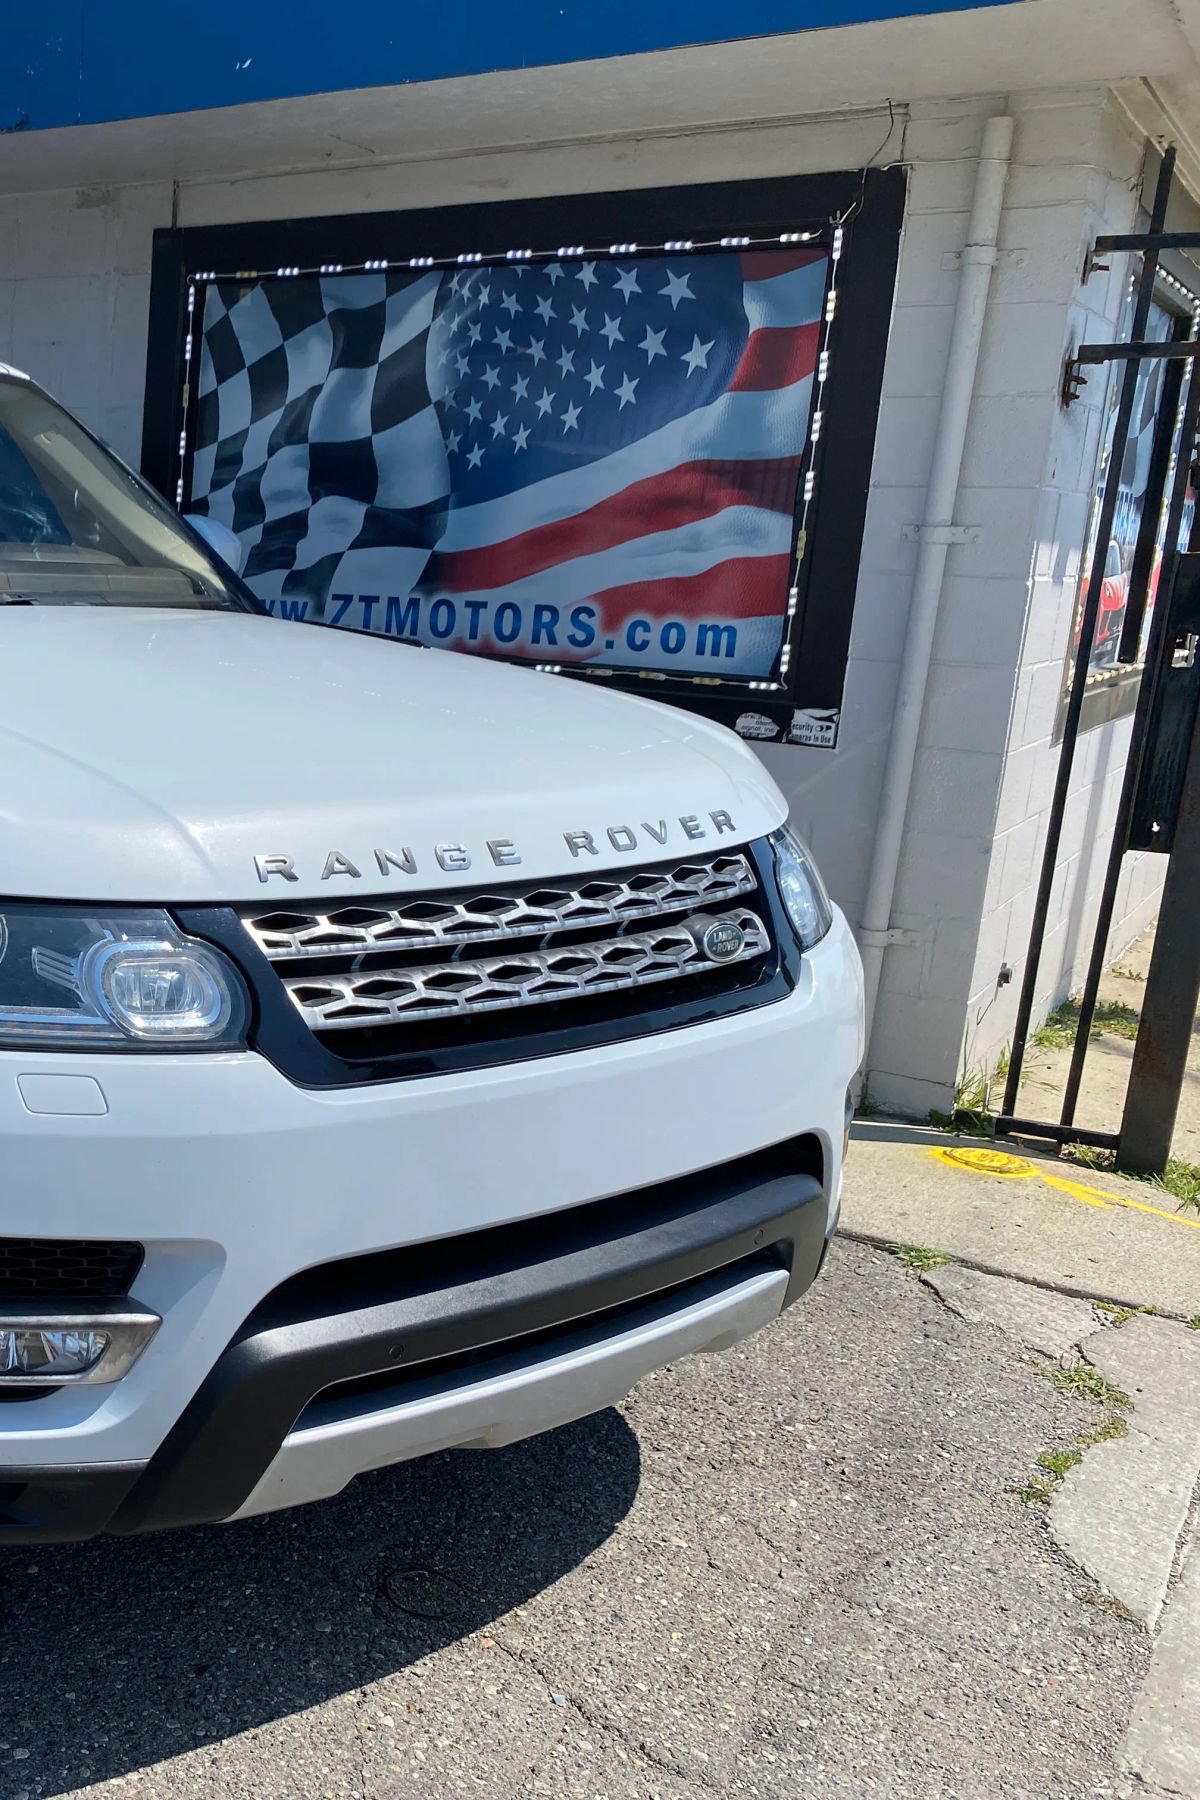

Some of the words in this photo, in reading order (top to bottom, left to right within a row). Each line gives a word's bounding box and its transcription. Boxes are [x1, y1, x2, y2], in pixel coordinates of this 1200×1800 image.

[791, 722, 814, 734] ecurity
[820, 734, 832, 744] Use
[253, 839, 522, 882] RANGE
[563, 809, 738, 858] ROVER
[713, 930, 733, 942] LAND
[717, 939, 740, 953] ROVER
